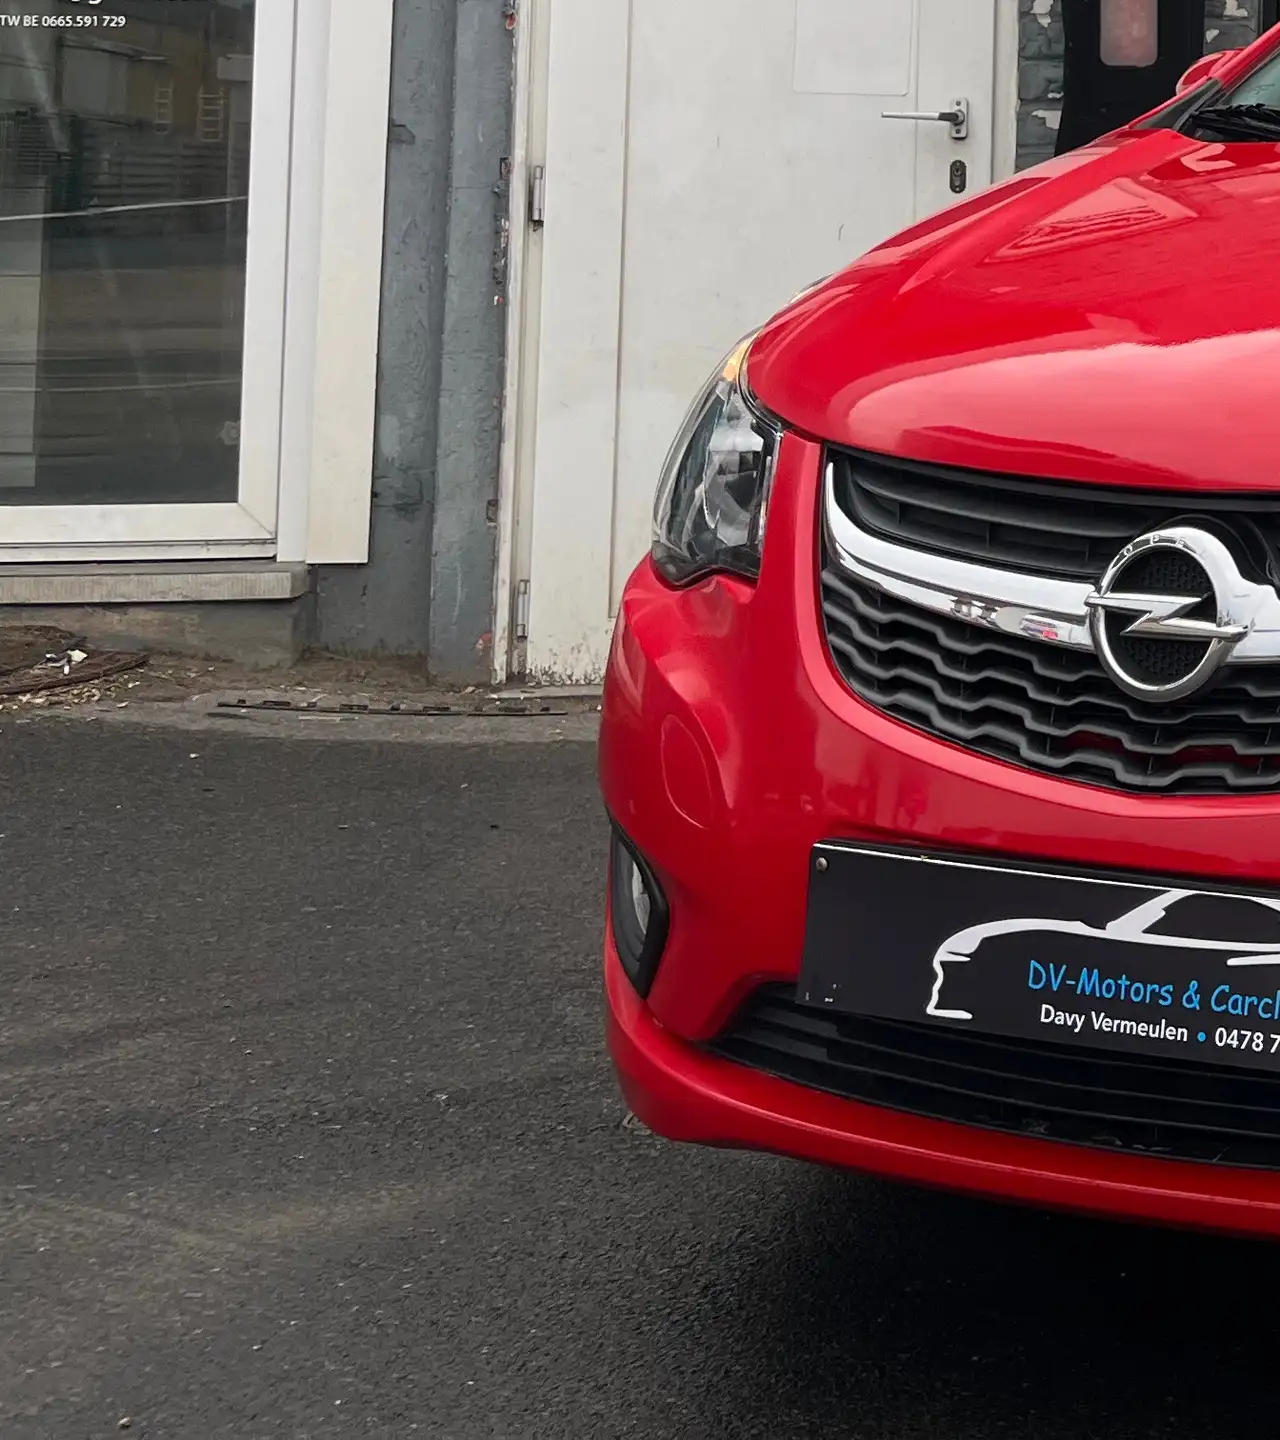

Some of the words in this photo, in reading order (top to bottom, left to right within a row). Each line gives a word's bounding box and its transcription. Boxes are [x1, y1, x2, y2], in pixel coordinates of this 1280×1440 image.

[22, 15, 40, 27] BE
[41, 15, 98, 27] 0665.591
[102, 15, 127, 27] 729
[1028, 959, 1174, 1006] DV-Motors
[1182, 980, 1200, 1010] &
[1040, 1003, 1085, 1033] Davy
[1091, 1010, 1188, 1042] Vermeulen
[1214, 1027, 1264, 1052] 0478
